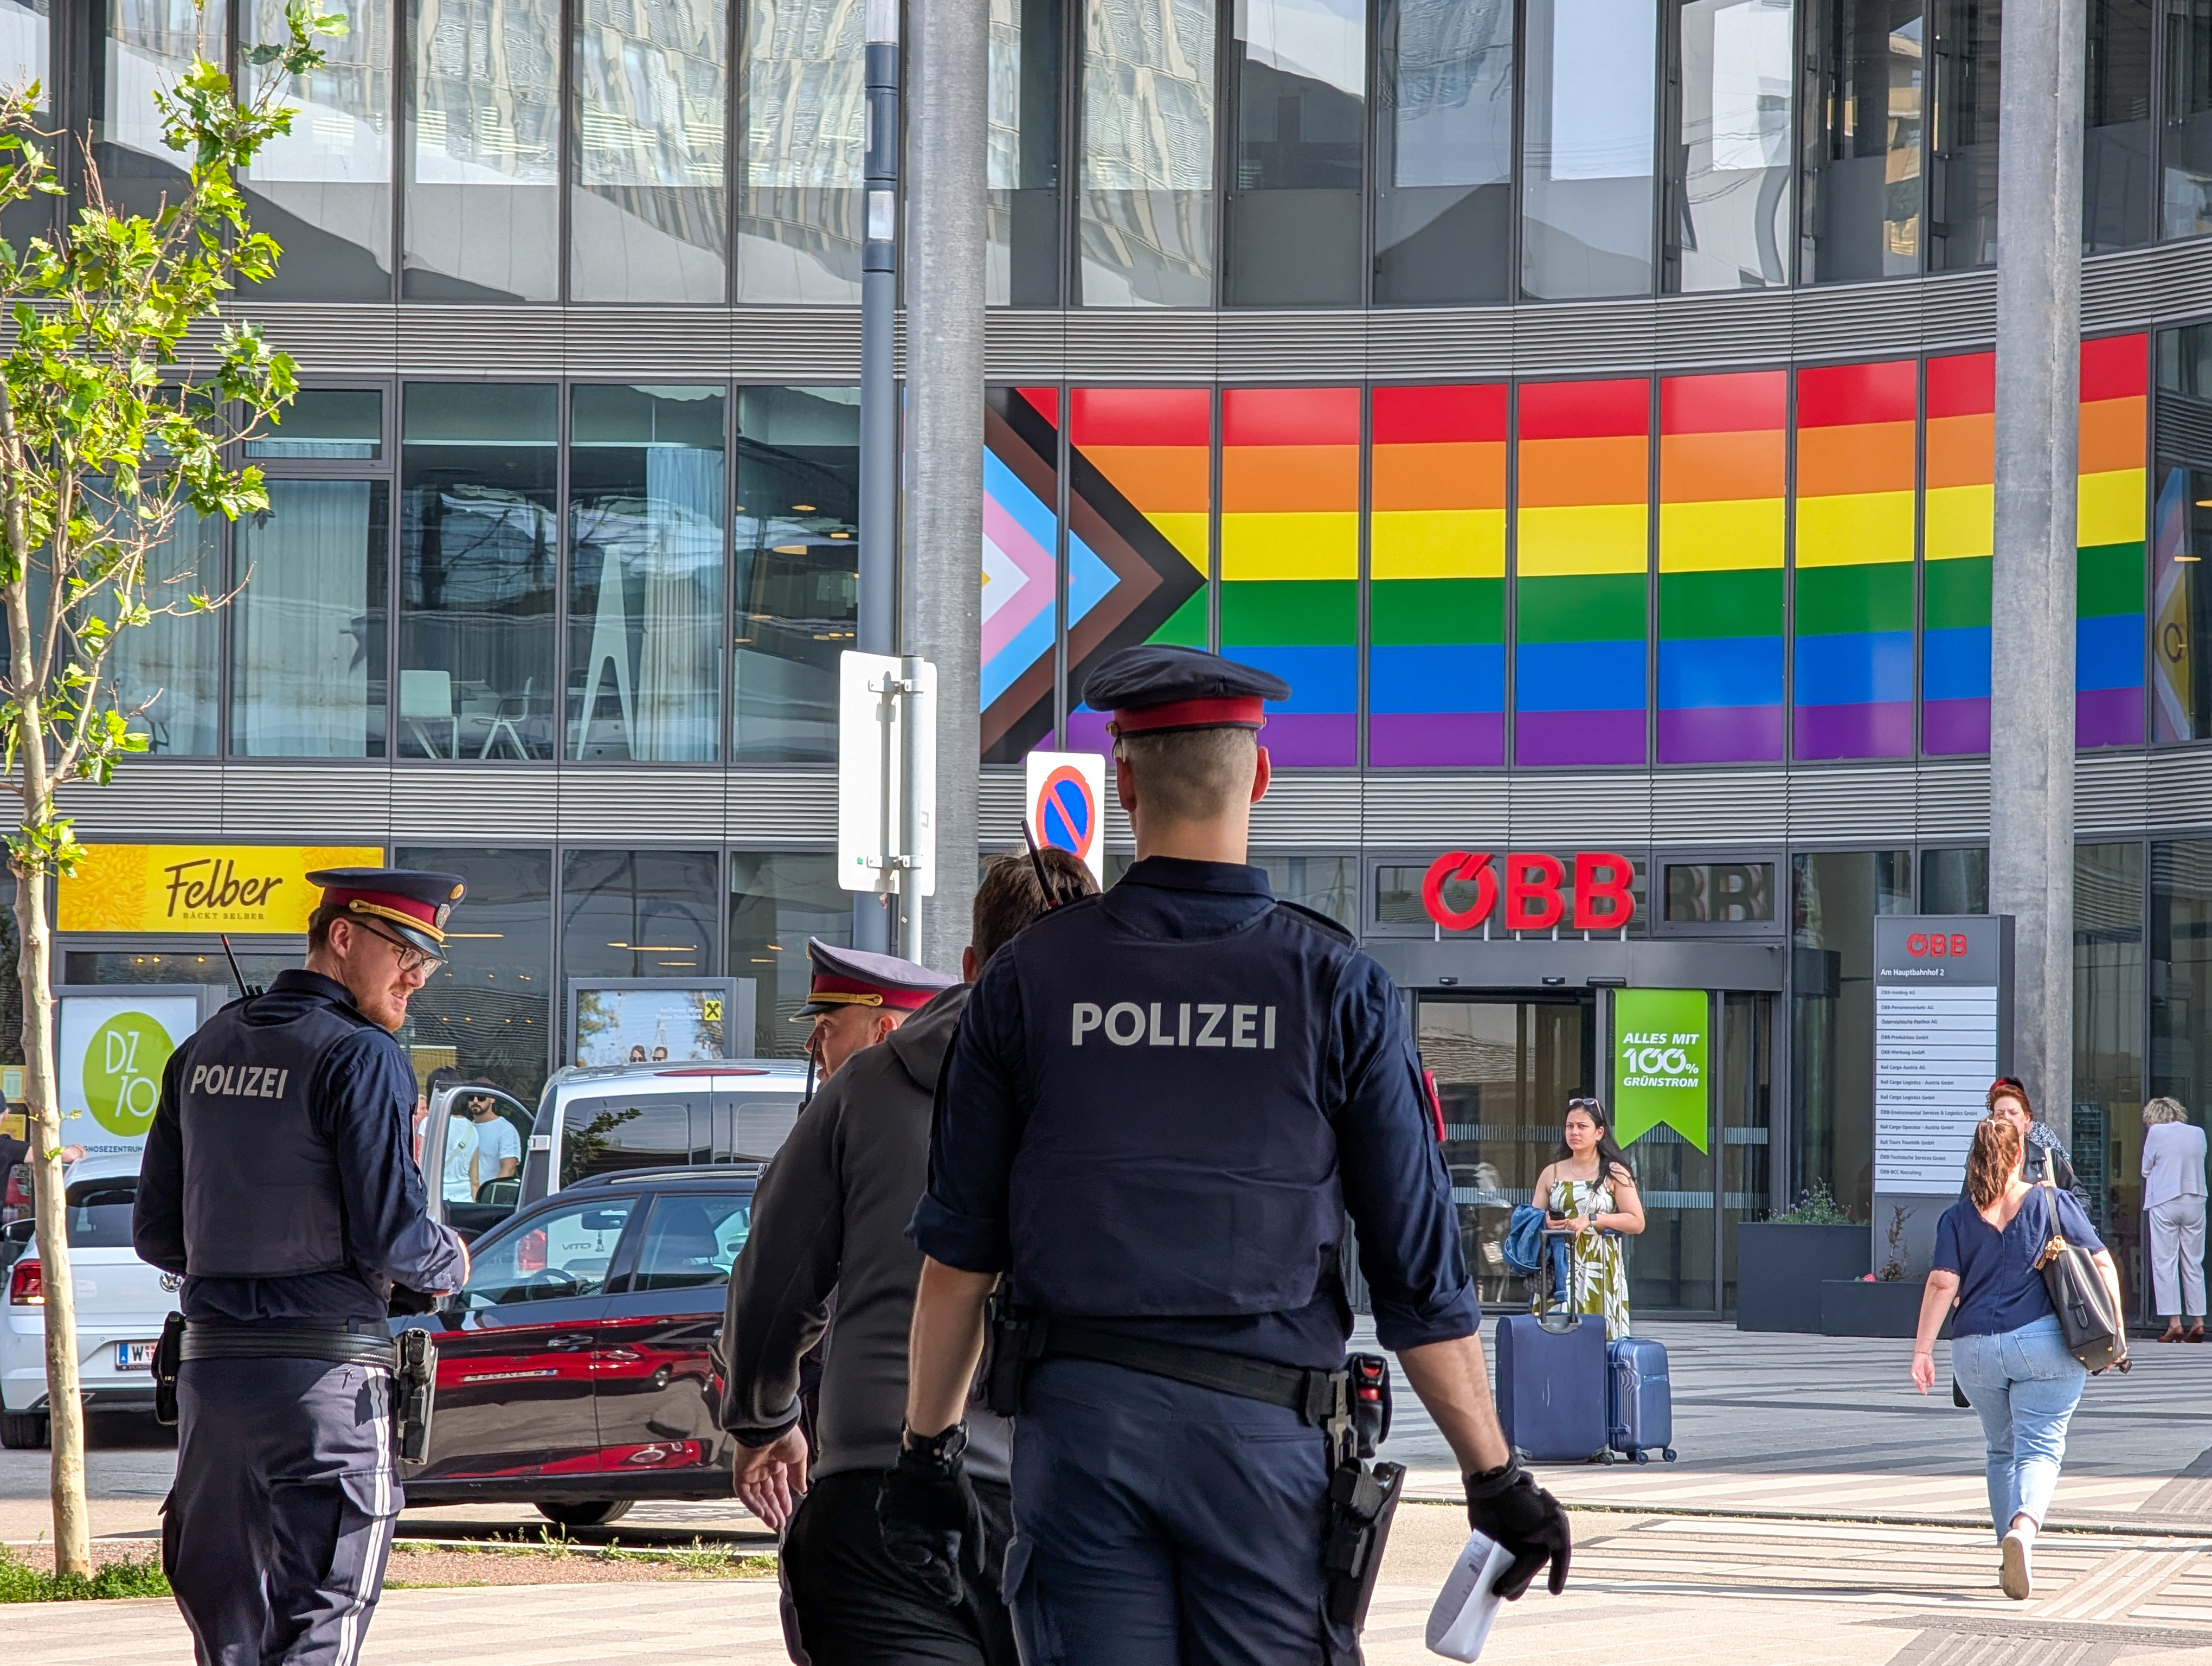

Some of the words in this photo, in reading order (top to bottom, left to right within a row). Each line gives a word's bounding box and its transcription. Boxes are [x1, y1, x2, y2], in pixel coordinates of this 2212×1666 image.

[164, 858, 282, 917] Felber
[1422, 850, 1636, 931] ÖBB
[1907, 933, 1967, 957] ÖBB
[1893, 969, 1938, 977] Hauptbahnhof
[1072, 1002, 1276, 1049] POLIZEI
[1623, 1033, 1667, 1044] ALLES
[1671, 1034, 1700, 1045] MIT
[106, 1030, 139, 1074] DZ
[115, 1075, 158, 1117] 10
[190, 1065, 288, 1099] POLIZEI
[1623, 1075, 1699, 1087] GRÜNSTROM
